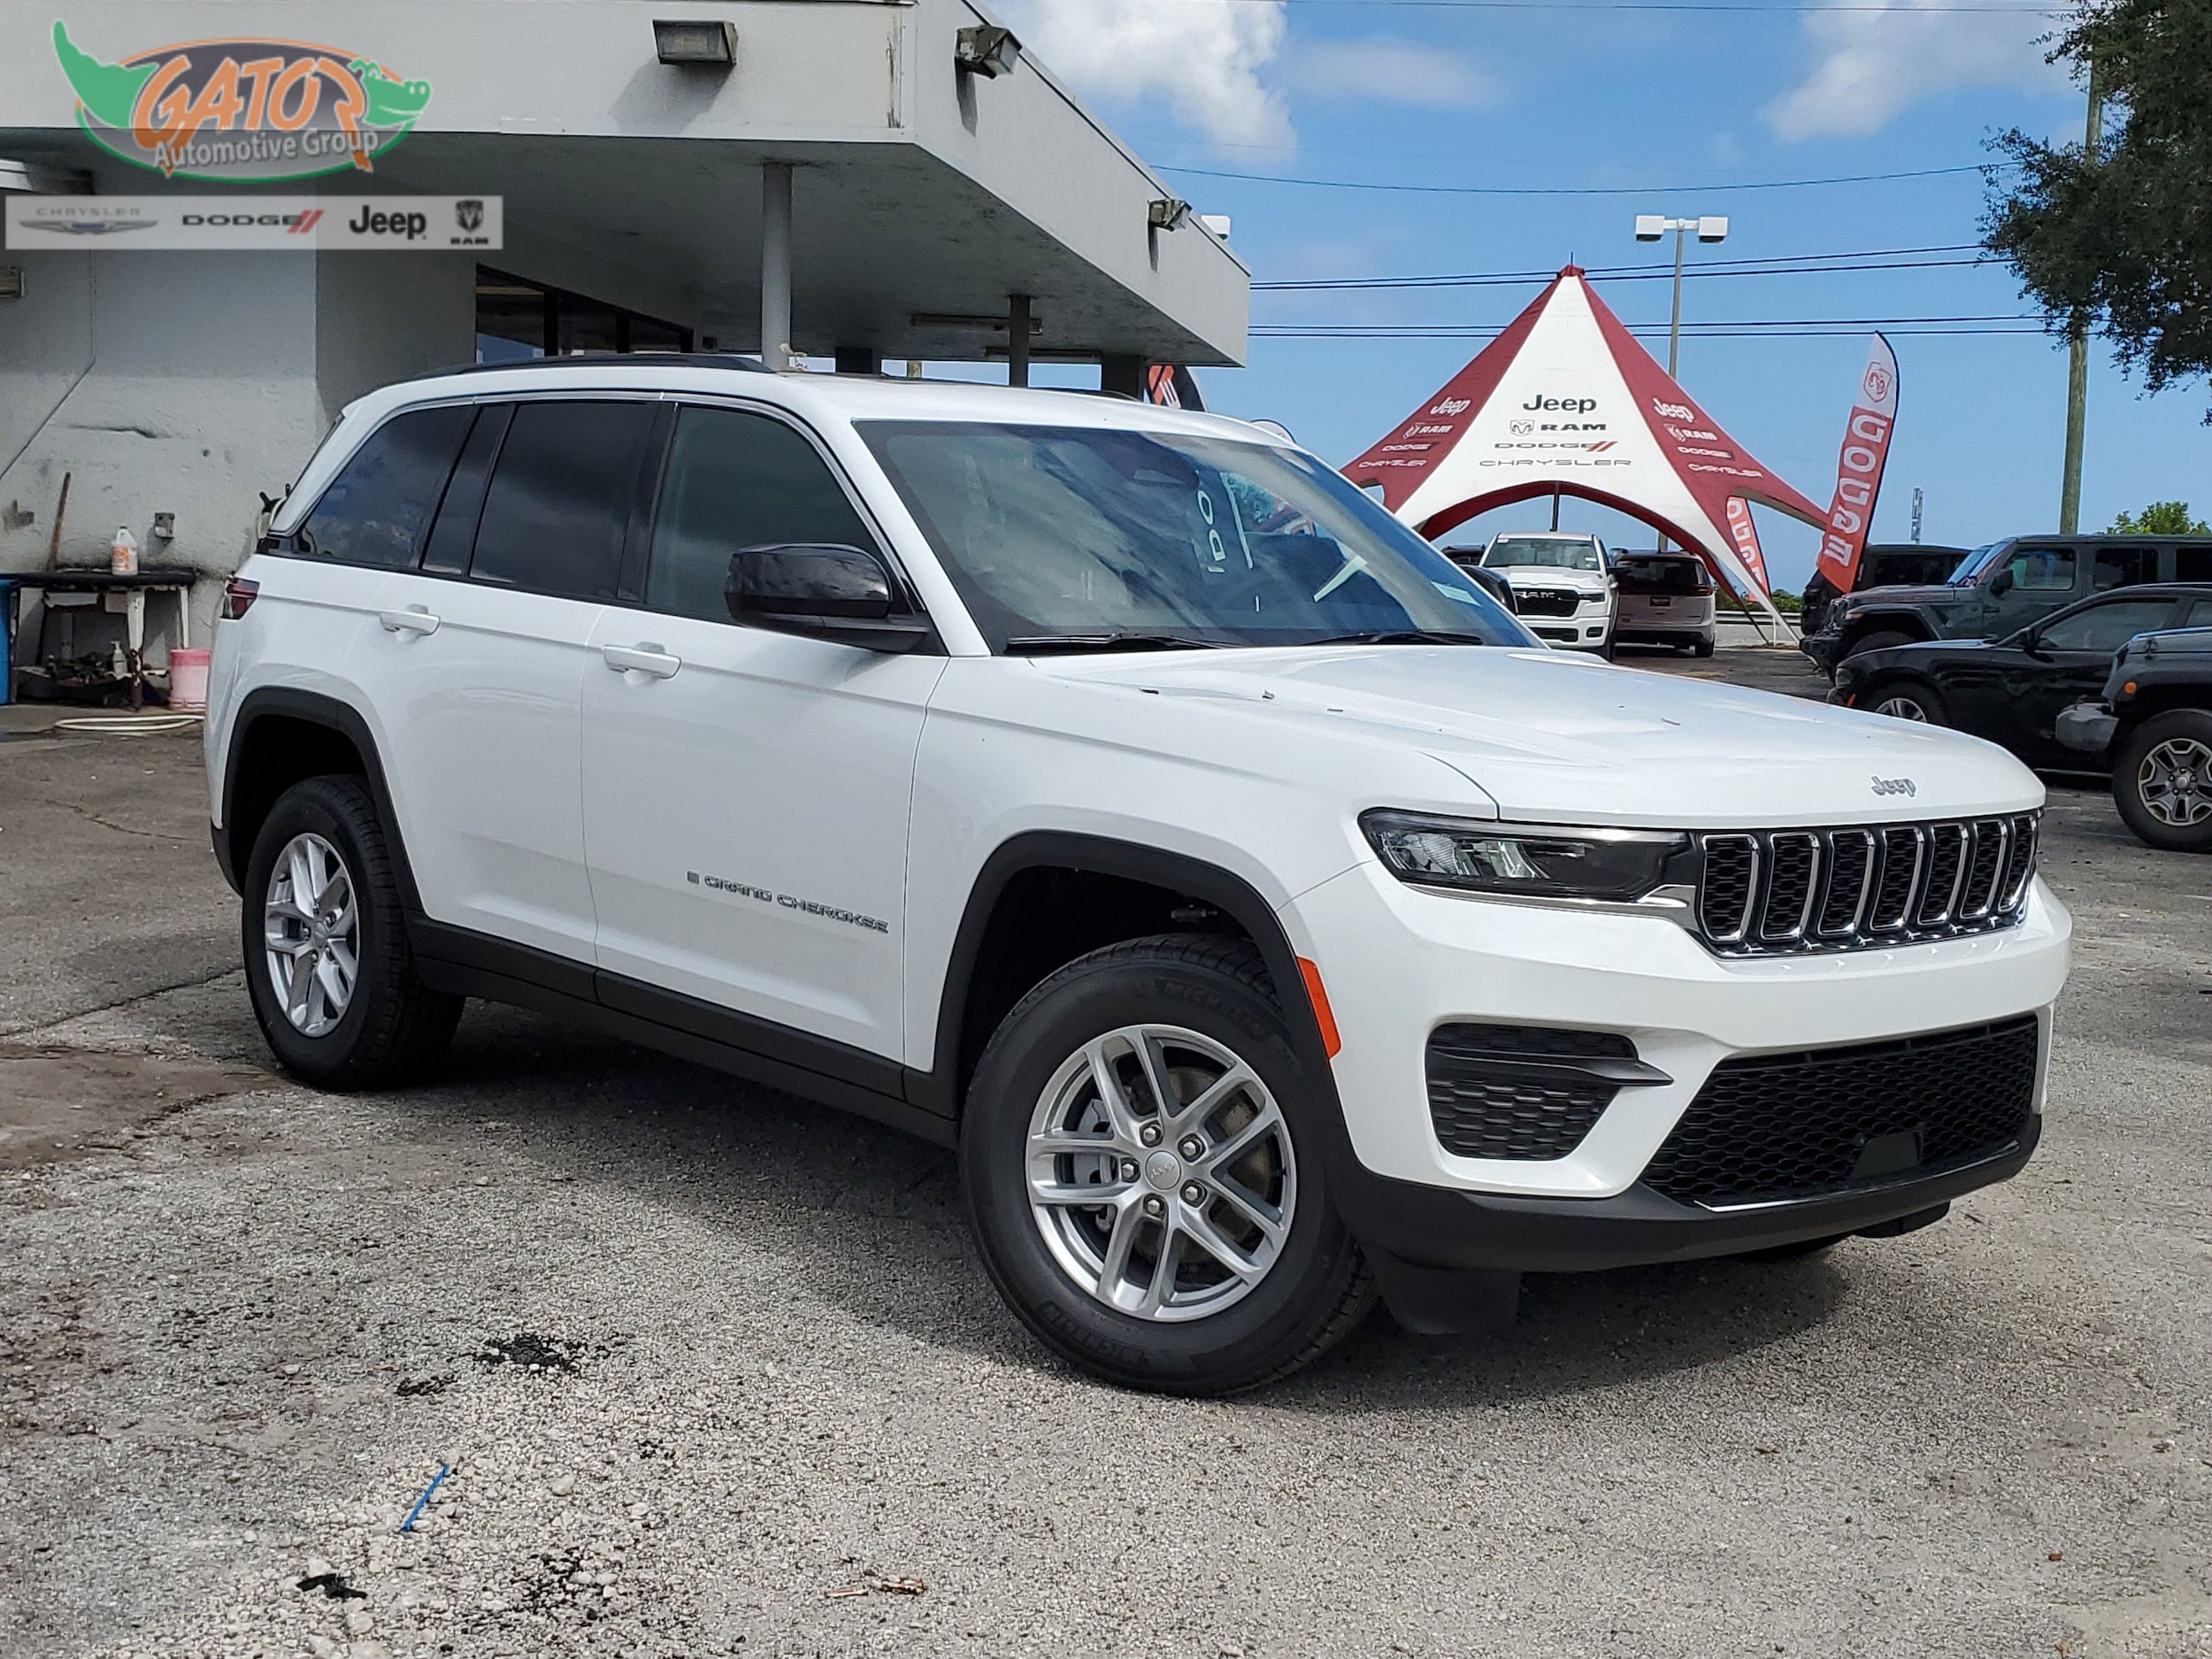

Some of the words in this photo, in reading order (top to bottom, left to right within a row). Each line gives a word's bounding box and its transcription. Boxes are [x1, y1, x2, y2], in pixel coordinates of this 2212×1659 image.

[1429, 396, 1471, 417] Jeep
[1522, 394, 1597, 414] Jeep
[1652, 397, 1695, 424] Jeep
[1417, 425, 1454, 434] RAM
[1540, 423, 1607, 432] RAM
[1680, 428, 1718, 442] RAM
[1381, 443, 1432, 452] DODGE
[1677, 446, 1732, 459] DODGE
[1357, 459, 1427, 468] CHRYSLER
[1479, 458, 1632, 467] CHRYSLER
[1870, 775, 1916, 798] Jeep
[704, 875, 772, 902] GRAND
[777, 894, 889, 934] CHEROKEE
